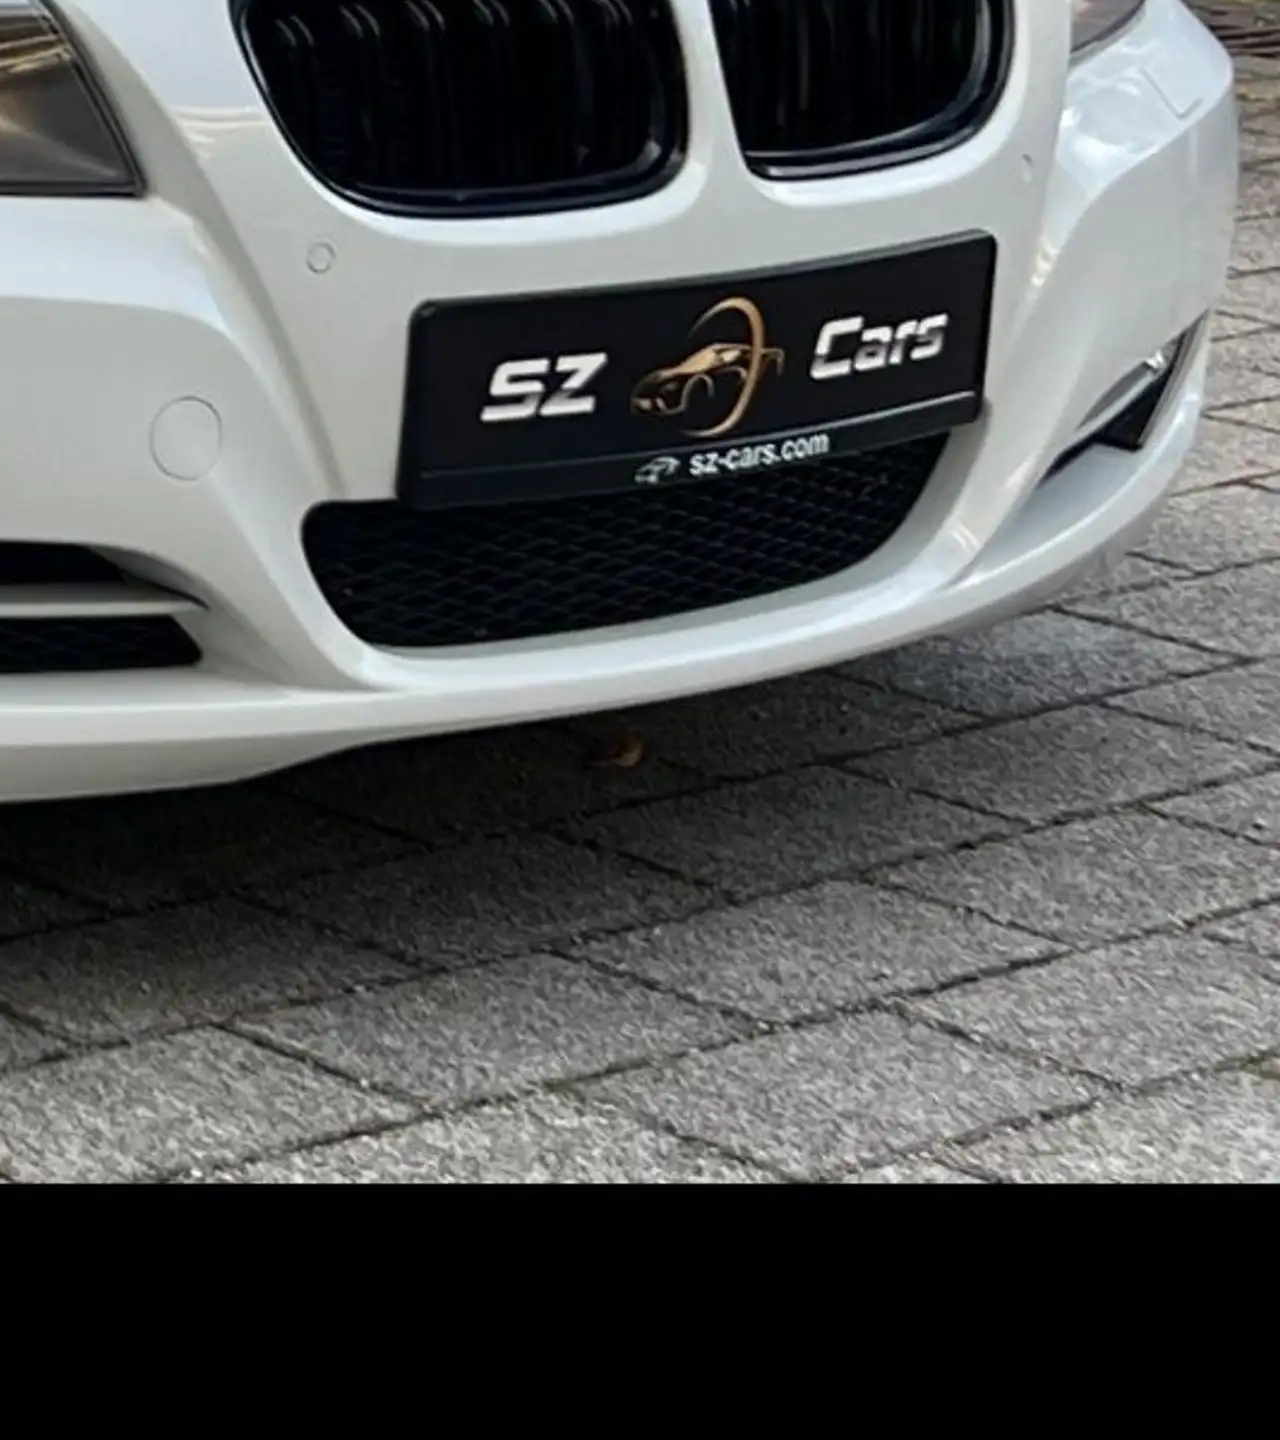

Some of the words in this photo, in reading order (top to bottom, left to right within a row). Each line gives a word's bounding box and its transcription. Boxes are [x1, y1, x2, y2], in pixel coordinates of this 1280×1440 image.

[479, 352, 608, 422] SZ
[810, 314, 948, 380] Cars
[688, 431, 829, 477] sz-cars.com
